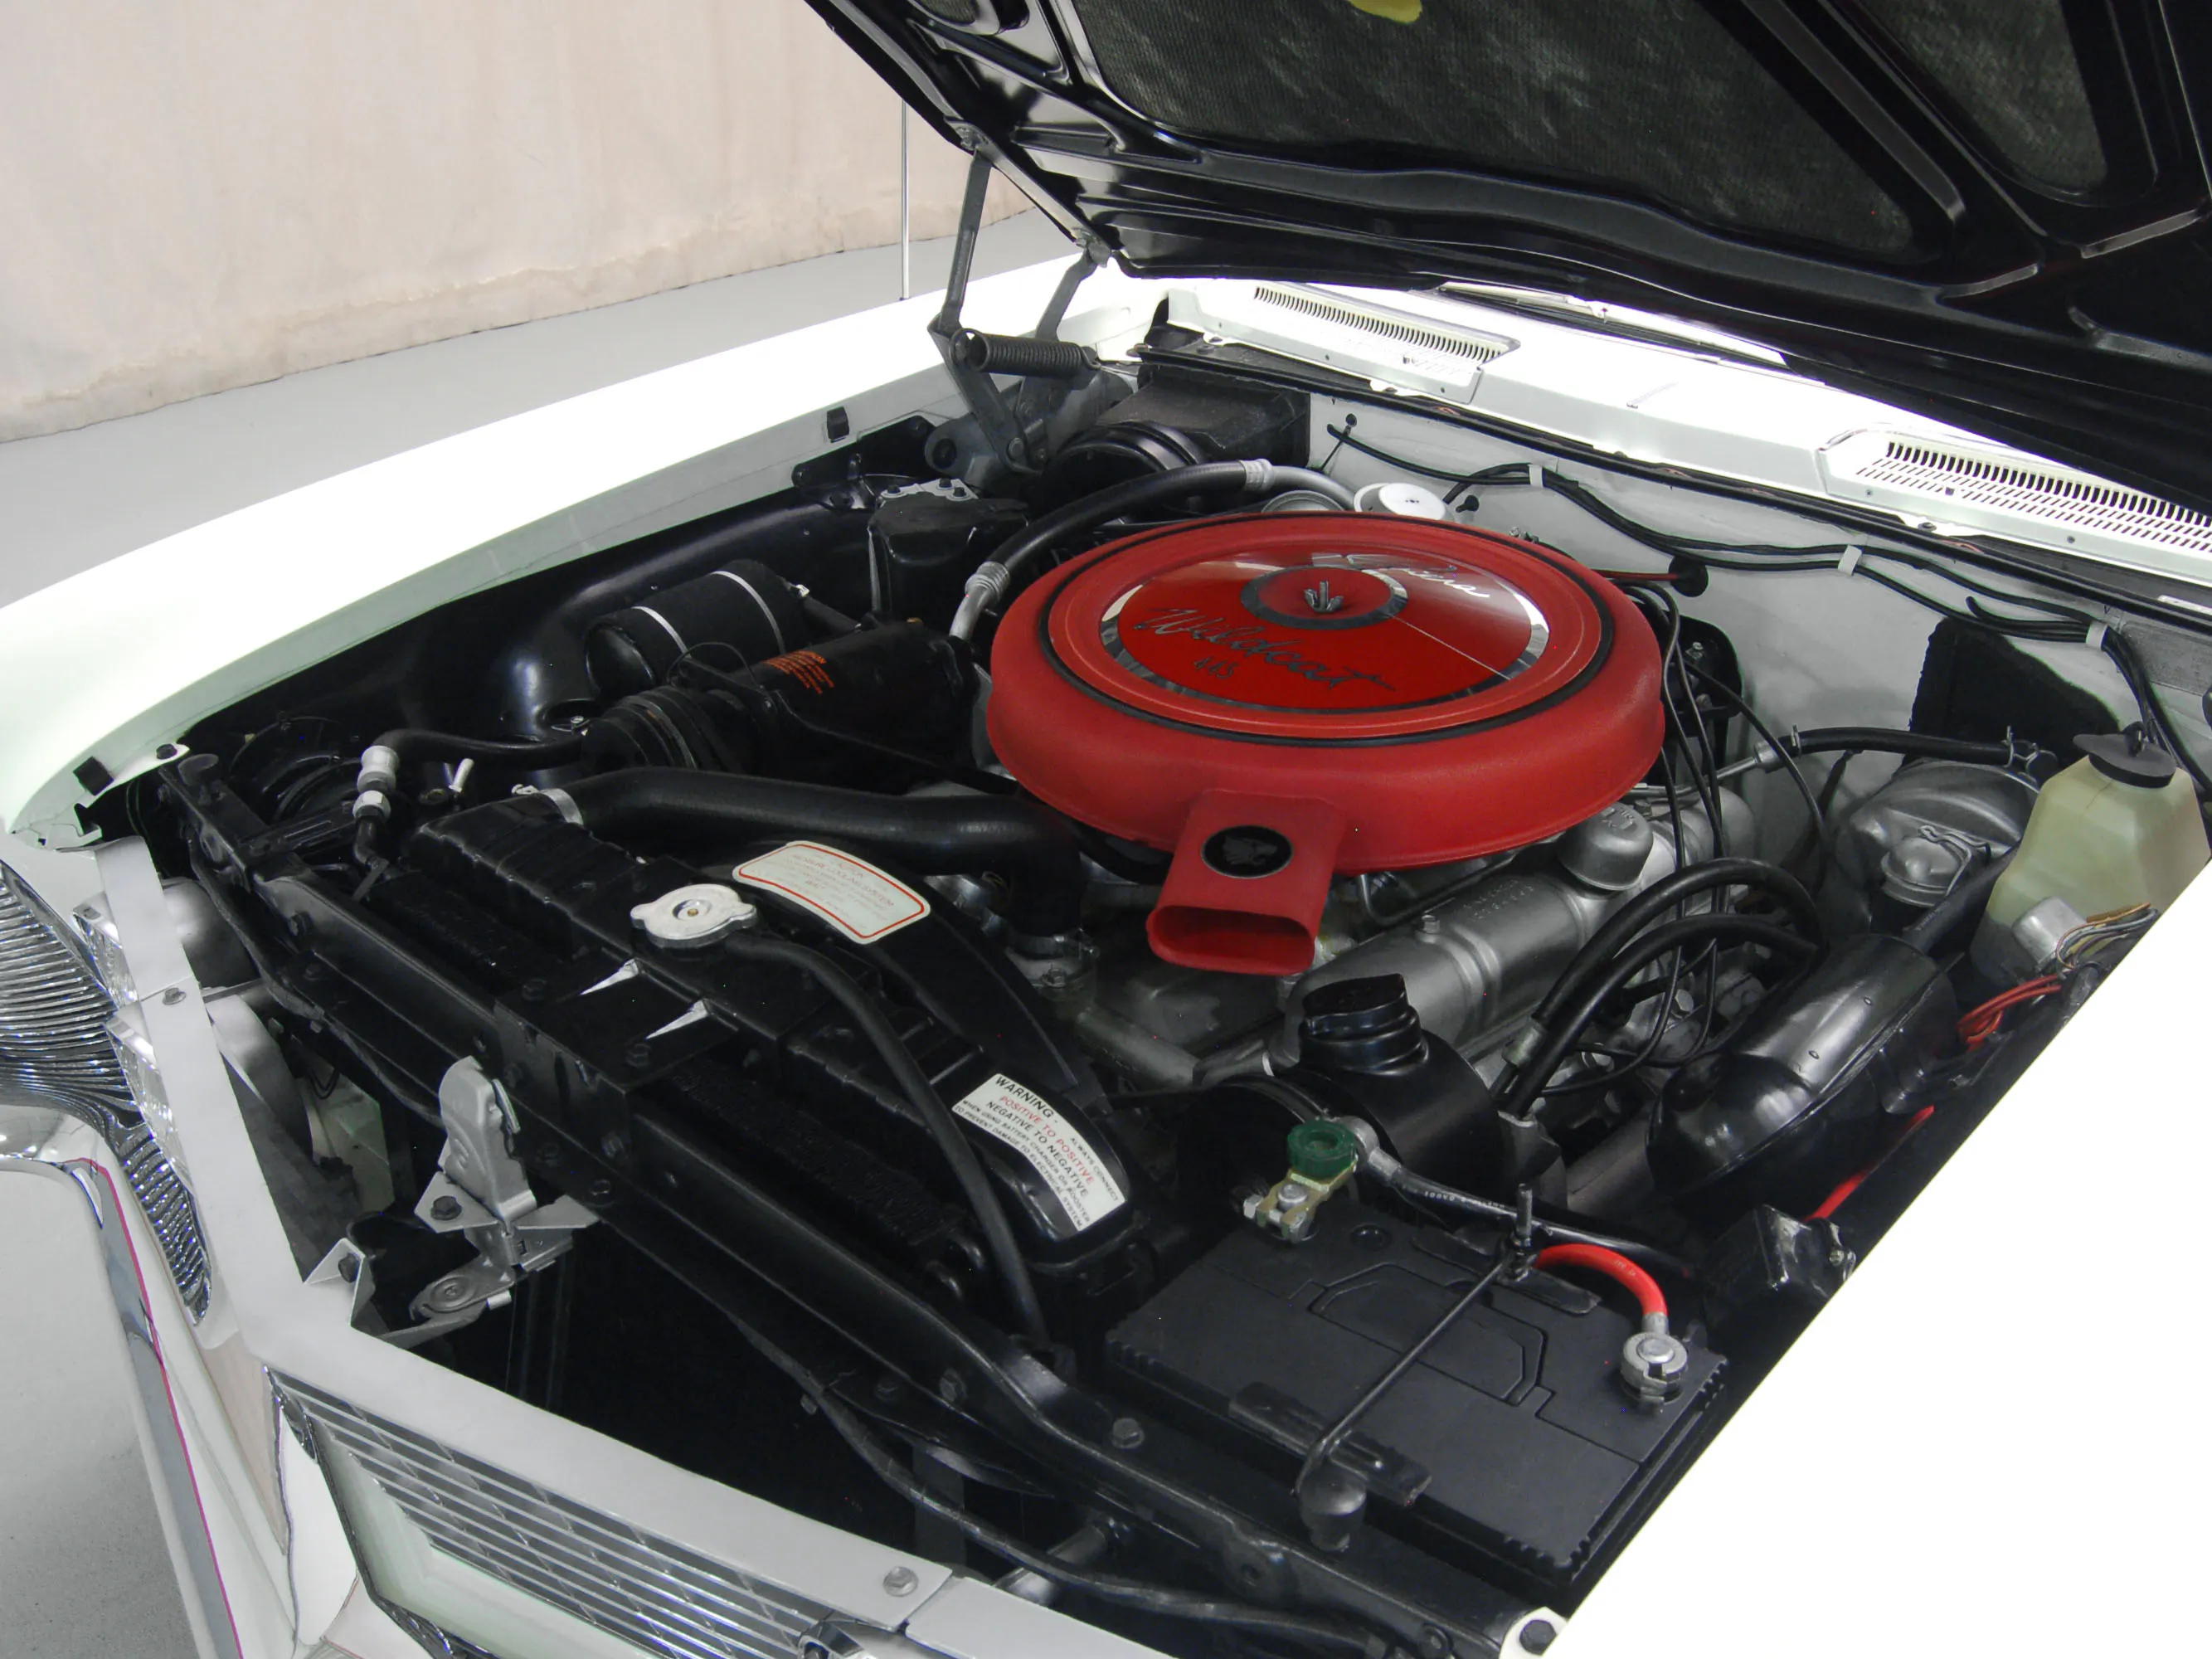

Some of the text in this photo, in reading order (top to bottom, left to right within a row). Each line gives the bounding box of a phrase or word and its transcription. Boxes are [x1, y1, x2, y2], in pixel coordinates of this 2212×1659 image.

[1133, 608, 1396, 691] Wildcat
[986, 1101, 1089, 1197] NEGATIVE TO NEGATIVE
[992, 1127, 1020, 1145] DAMAGE
[1029, 1153, 1062, 1194] ELECTRICAL
[995, 1076, 1055, 1118] WARNING
[1069, 1137, 1095, 1165] ALWAYS
[1093, 1165, 1119, 1201] CONNECT
[1000, 1095, 1095, 1185] POSITIVE TO POSITIVE
[1001, 1122, 1029, 1141] BATTERY
[1029, 1141, 1060, 1174] CHARGER
[1066, 1187, 1091, 1223] BOOSTER
